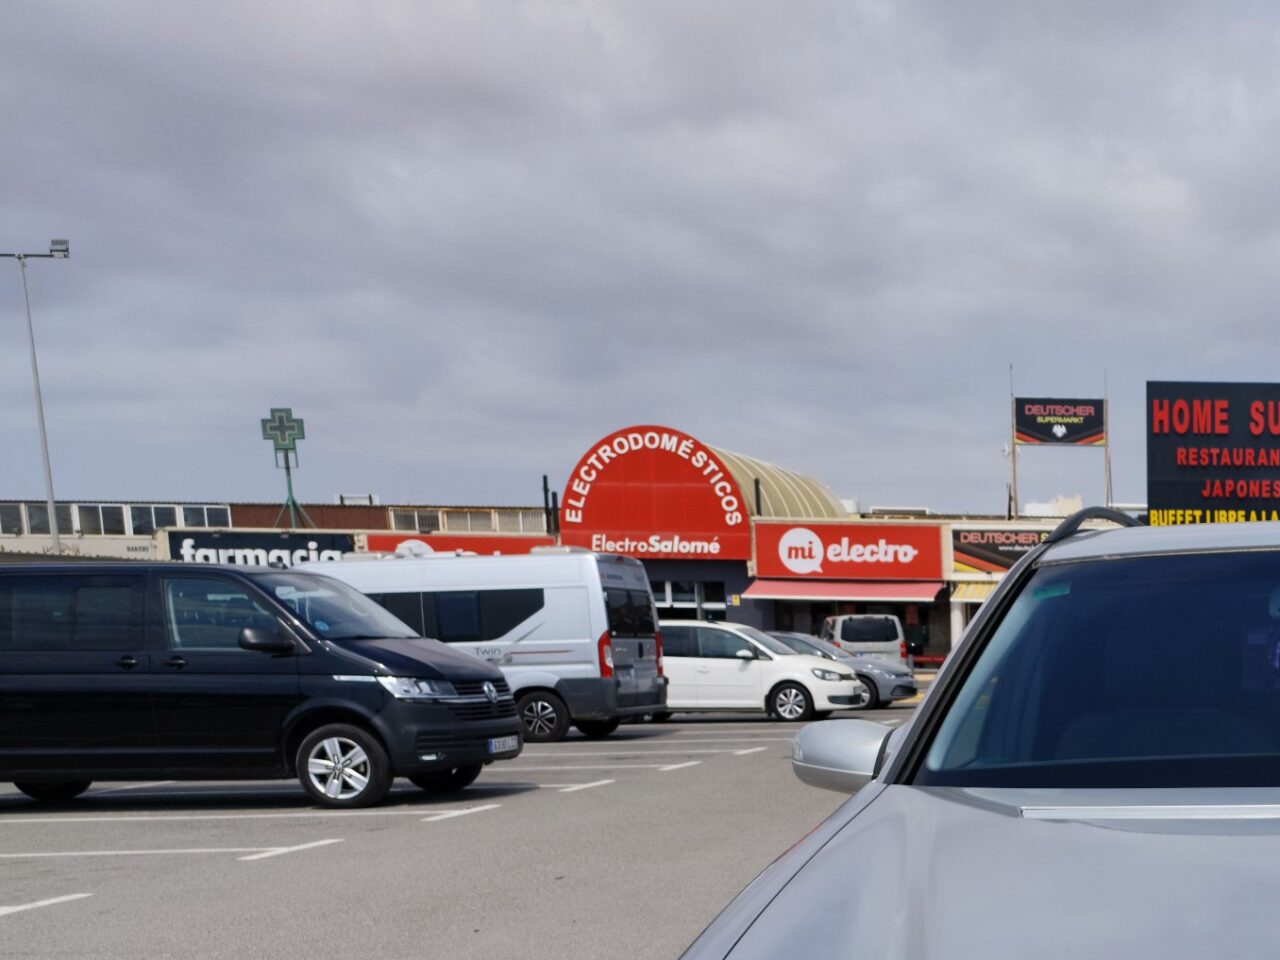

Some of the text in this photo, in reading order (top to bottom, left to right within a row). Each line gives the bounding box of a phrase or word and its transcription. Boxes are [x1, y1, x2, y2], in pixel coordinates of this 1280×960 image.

[1024, 404, 1094, 416] DEUTSCHER
[1153, 399, 1229, 434] HOME
[1036, 416, 1084, 424] SUPERMARKT
[565, 431, 742, 526] ELECTRODOMÉSTICOS
[1150, 509, 1202, 527] BUFFET
[591, 534, 721, 554] ElectroSalomé
[960, 532, 1039, 544] DEUTSCHER
[787, 537, 918, 564] mi electro
